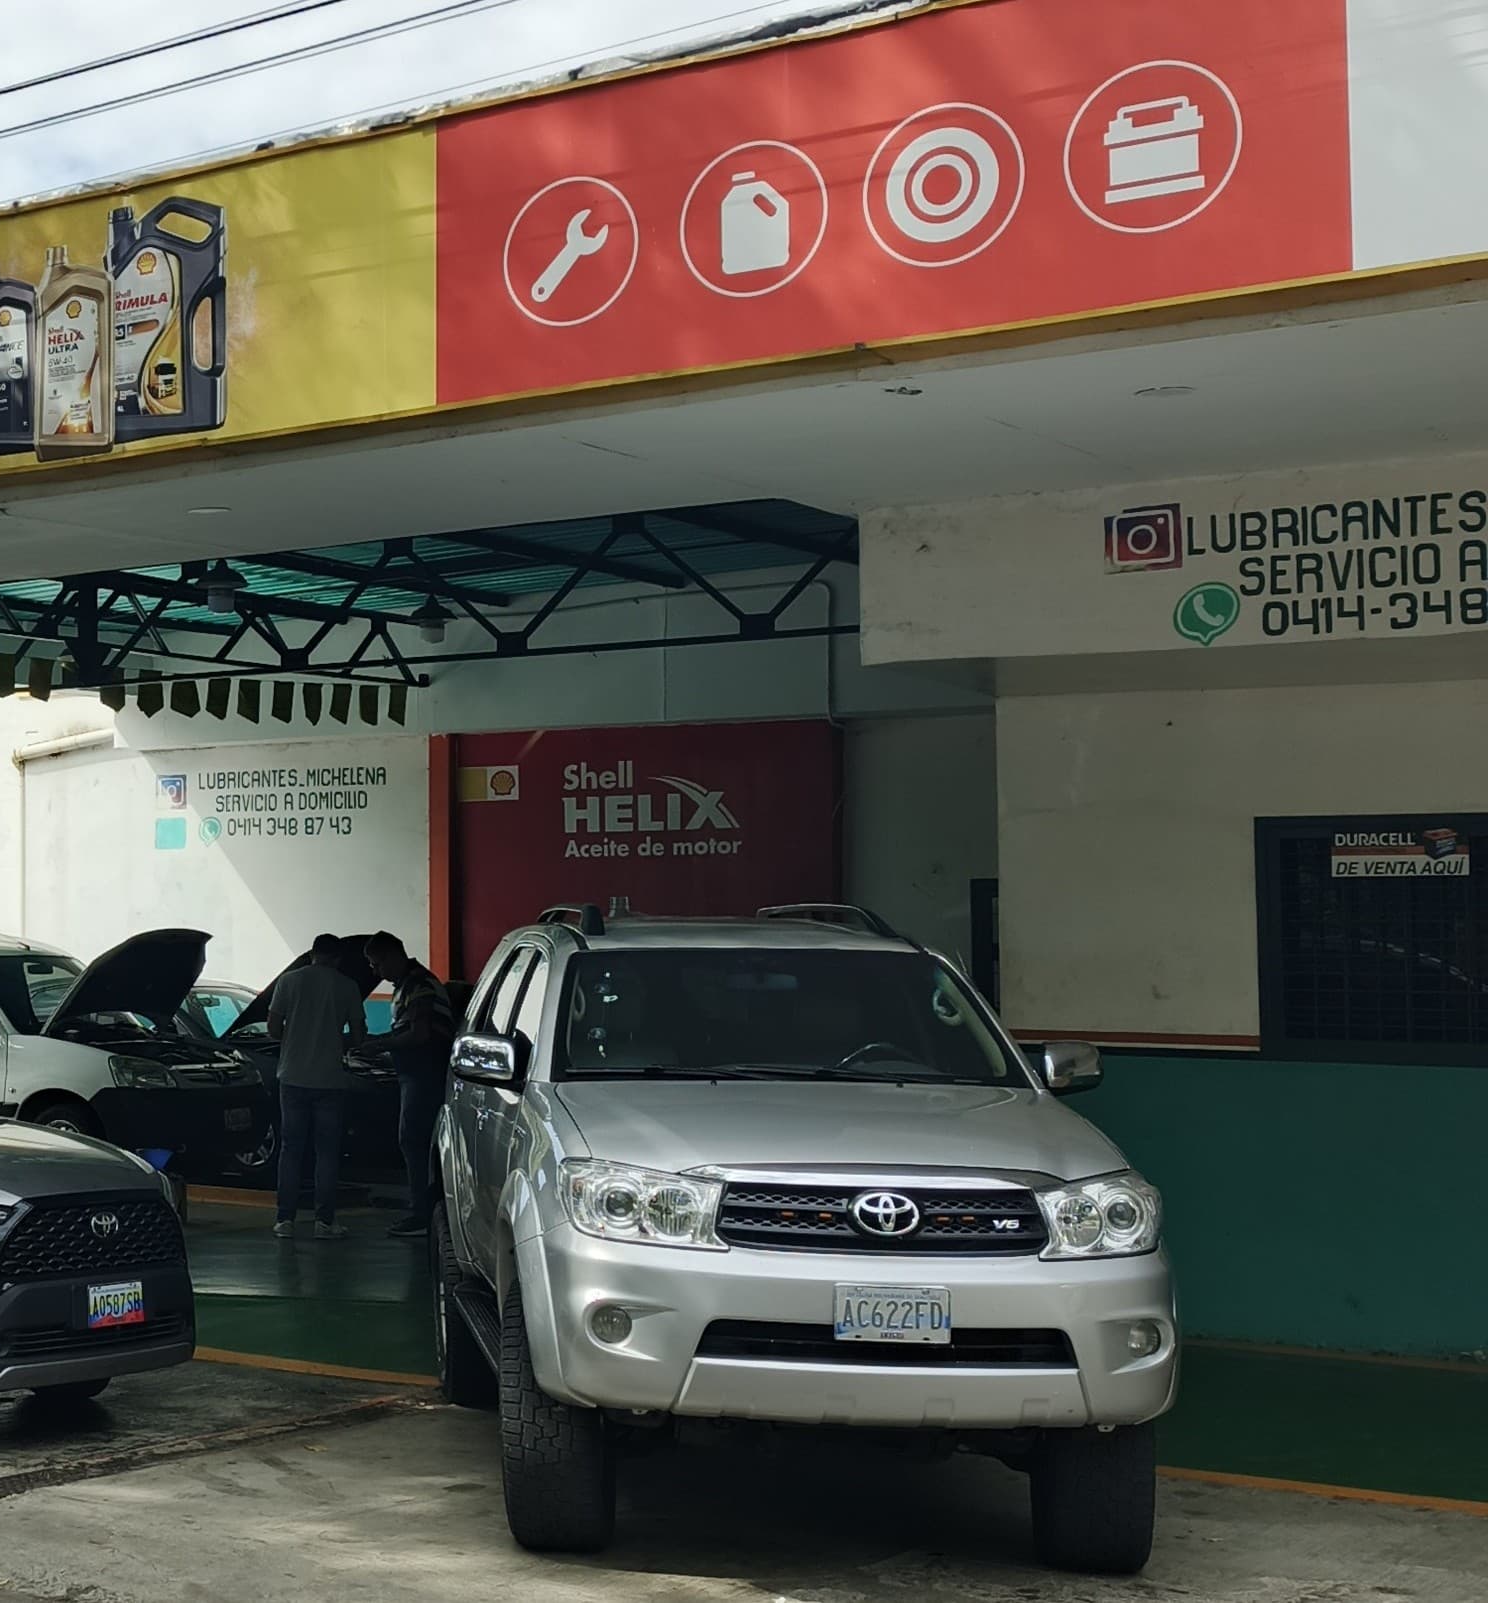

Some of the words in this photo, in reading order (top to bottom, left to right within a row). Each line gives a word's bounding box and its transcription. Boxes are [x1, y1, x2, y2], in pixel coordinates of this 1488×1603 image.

[48, 330, 85, 345] HELIX
[48, 343, 79, 355] ULTRA
[1187, 490, 1487, 556] LUBRICANTES
[1239, 542, 1441, 597] SERVICIO
[1459, 539, 1488, 582] A
[1262, 587, 1488, 637] 0414-348
[563, 760, 633, 790] Shell
[215, 793, 278, 812] SERVICIO
[284, 793, 294, 811] A
[298, 791, 368, 811] DOMICILIO
[562, 776, 741, 833] HELIX
[227, 817, 262, 836] 0414
[266, 817, 298, 836] 348
[305, 816, 324, 836] 87
[329, 816, 352, 835] 43
[564, 838, 630, 858] Aceite
[637, 836, 665, 856] de
[672, 838, 743, 856] motor
[1334, 832, 1417, 847] DURACELL
[1335, 861, 1359, 875] DE
[1364, 860, 1417, 875] VENTA
[1420, 856, 1466, 875] AQUÍ
[992, 1218, 1019, 1230] V6
[842, 1299, 944, 1331] AC622FD
